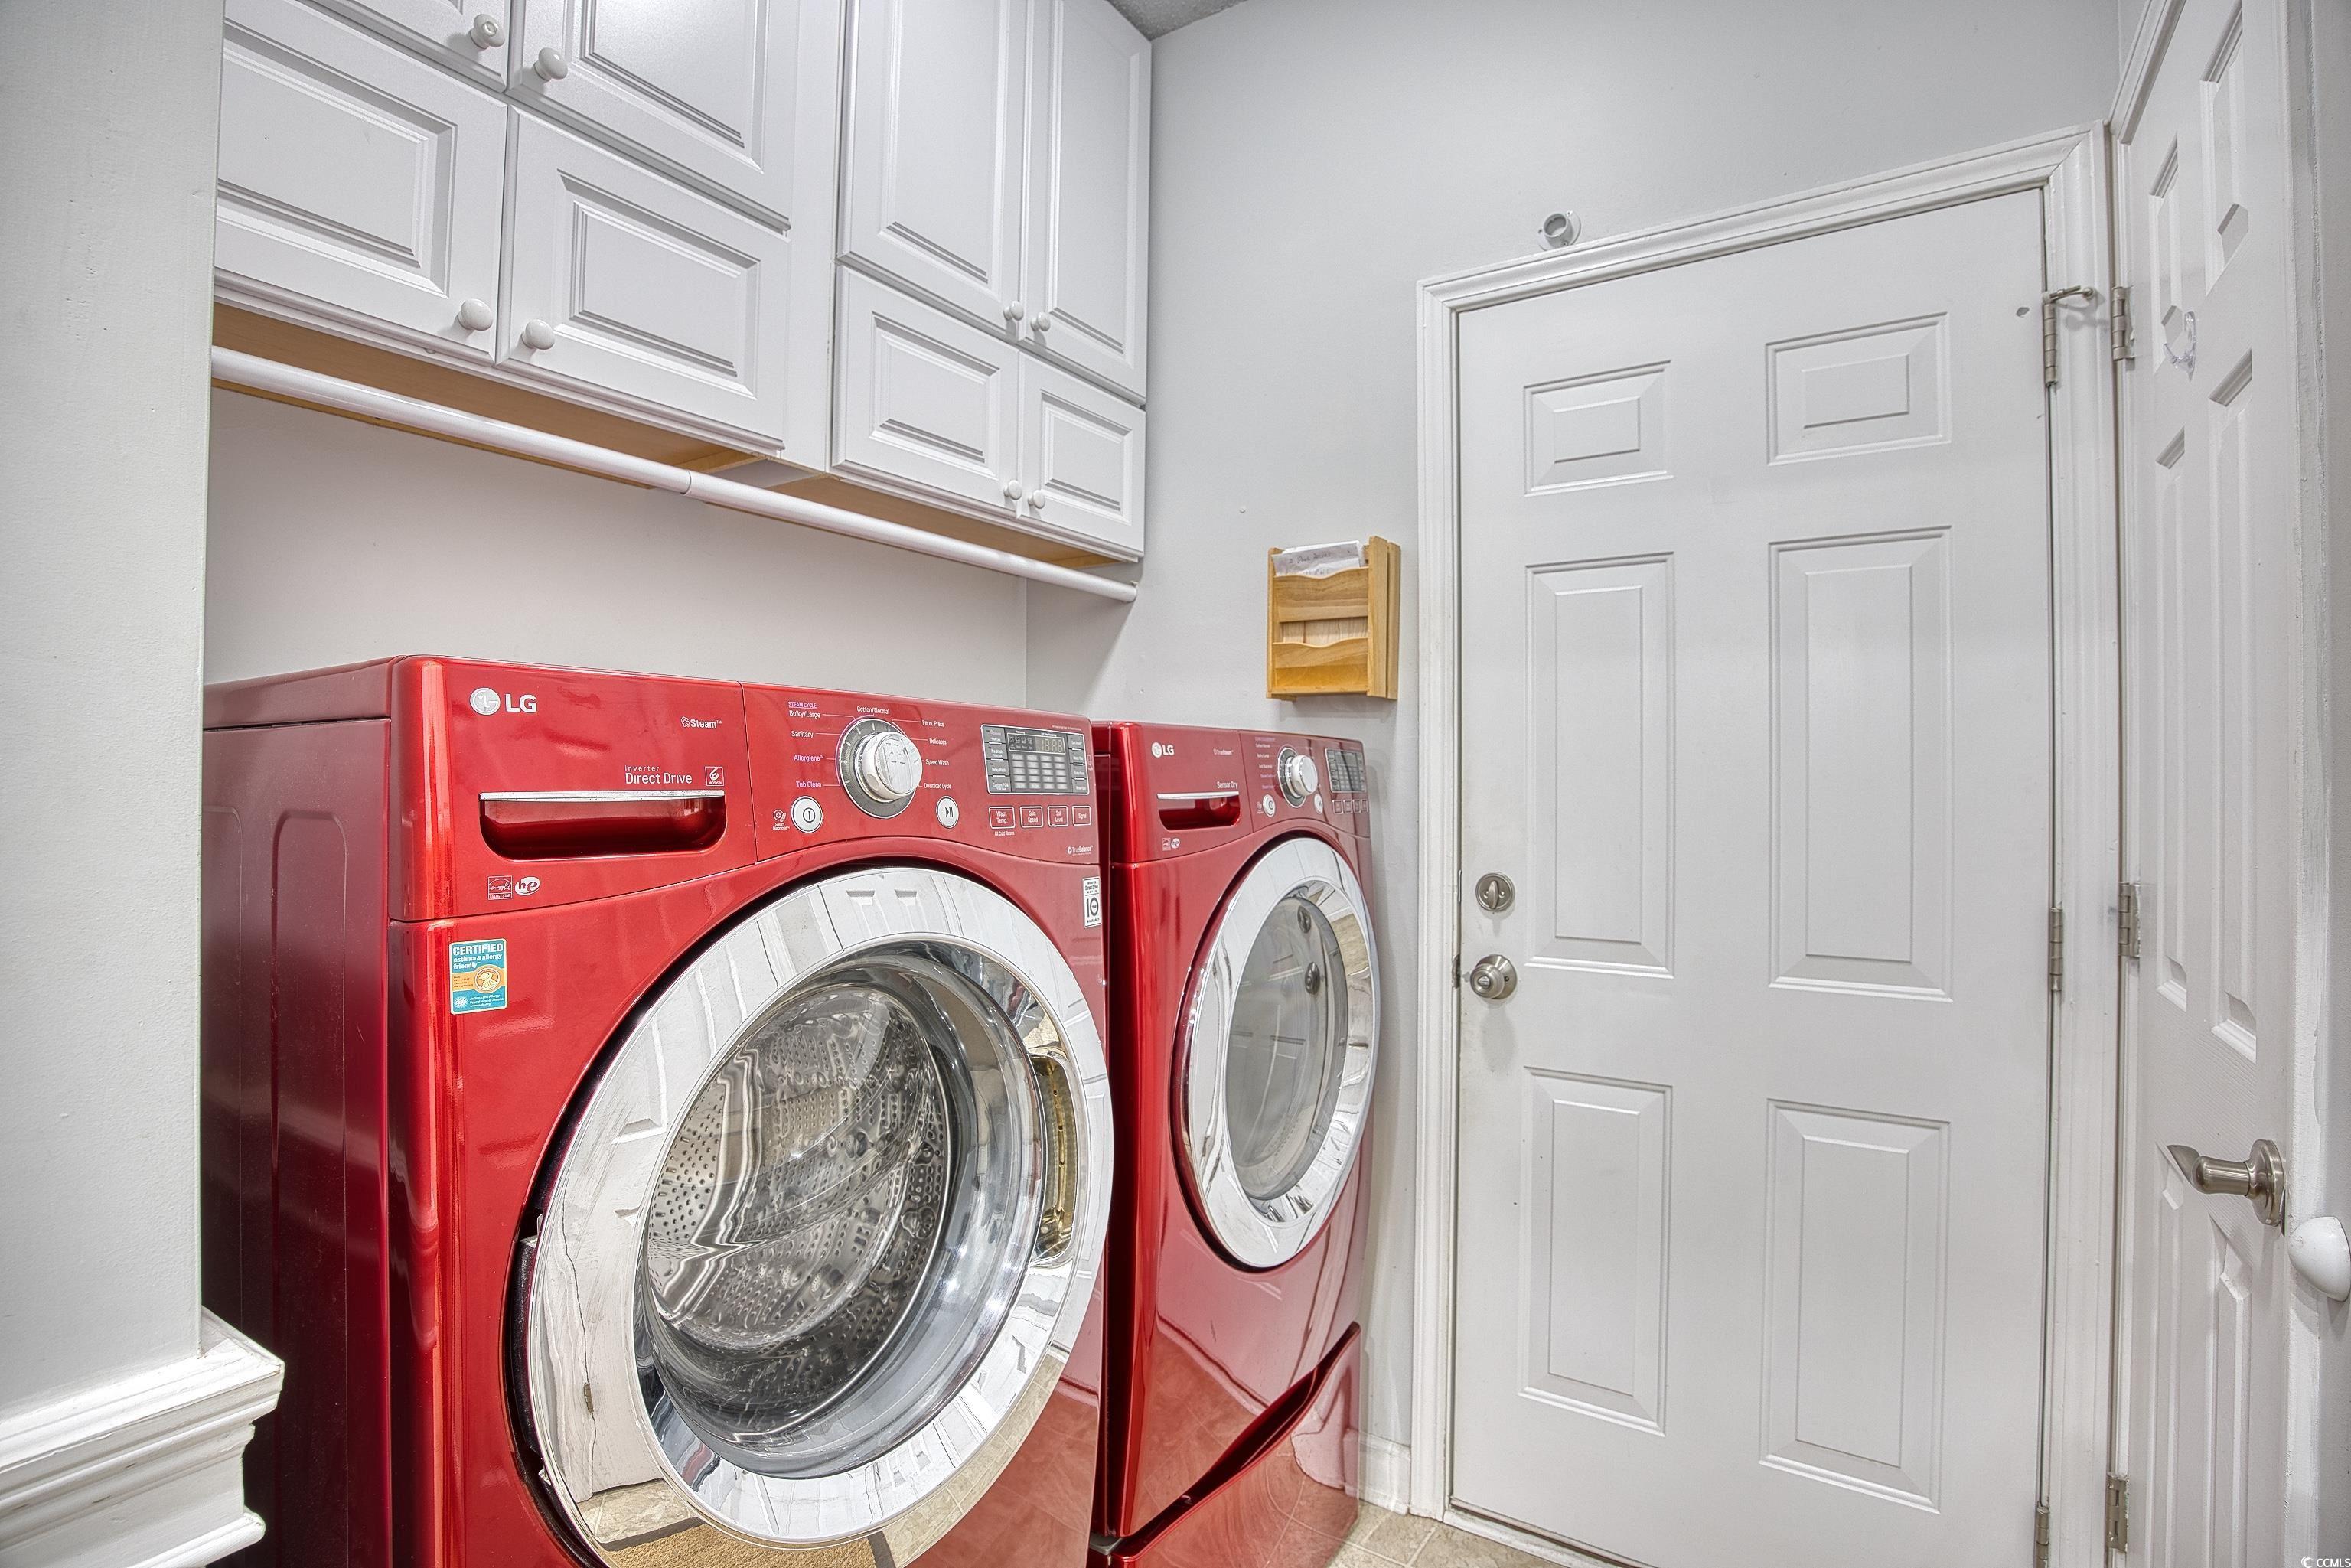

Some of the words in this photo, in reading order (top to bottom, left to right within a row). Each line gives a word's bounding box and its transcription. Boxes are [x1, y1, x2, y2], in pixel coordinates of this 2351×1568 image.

[505, 693, 537, 713] LG
[789, 709, 821, 719] Bulky/Large
[857, 706, 890, 715] Cotton/Normal
[791, 730, 814, 738] Sanitary
[1162, 744, 1175, 756] LG
[625, 772, 660, 784] Direct
[664, 772, 692, 784] Drive
[1086, 897, 1099, 918] 10
[452, 943, 504, 955] CERTIFIED
